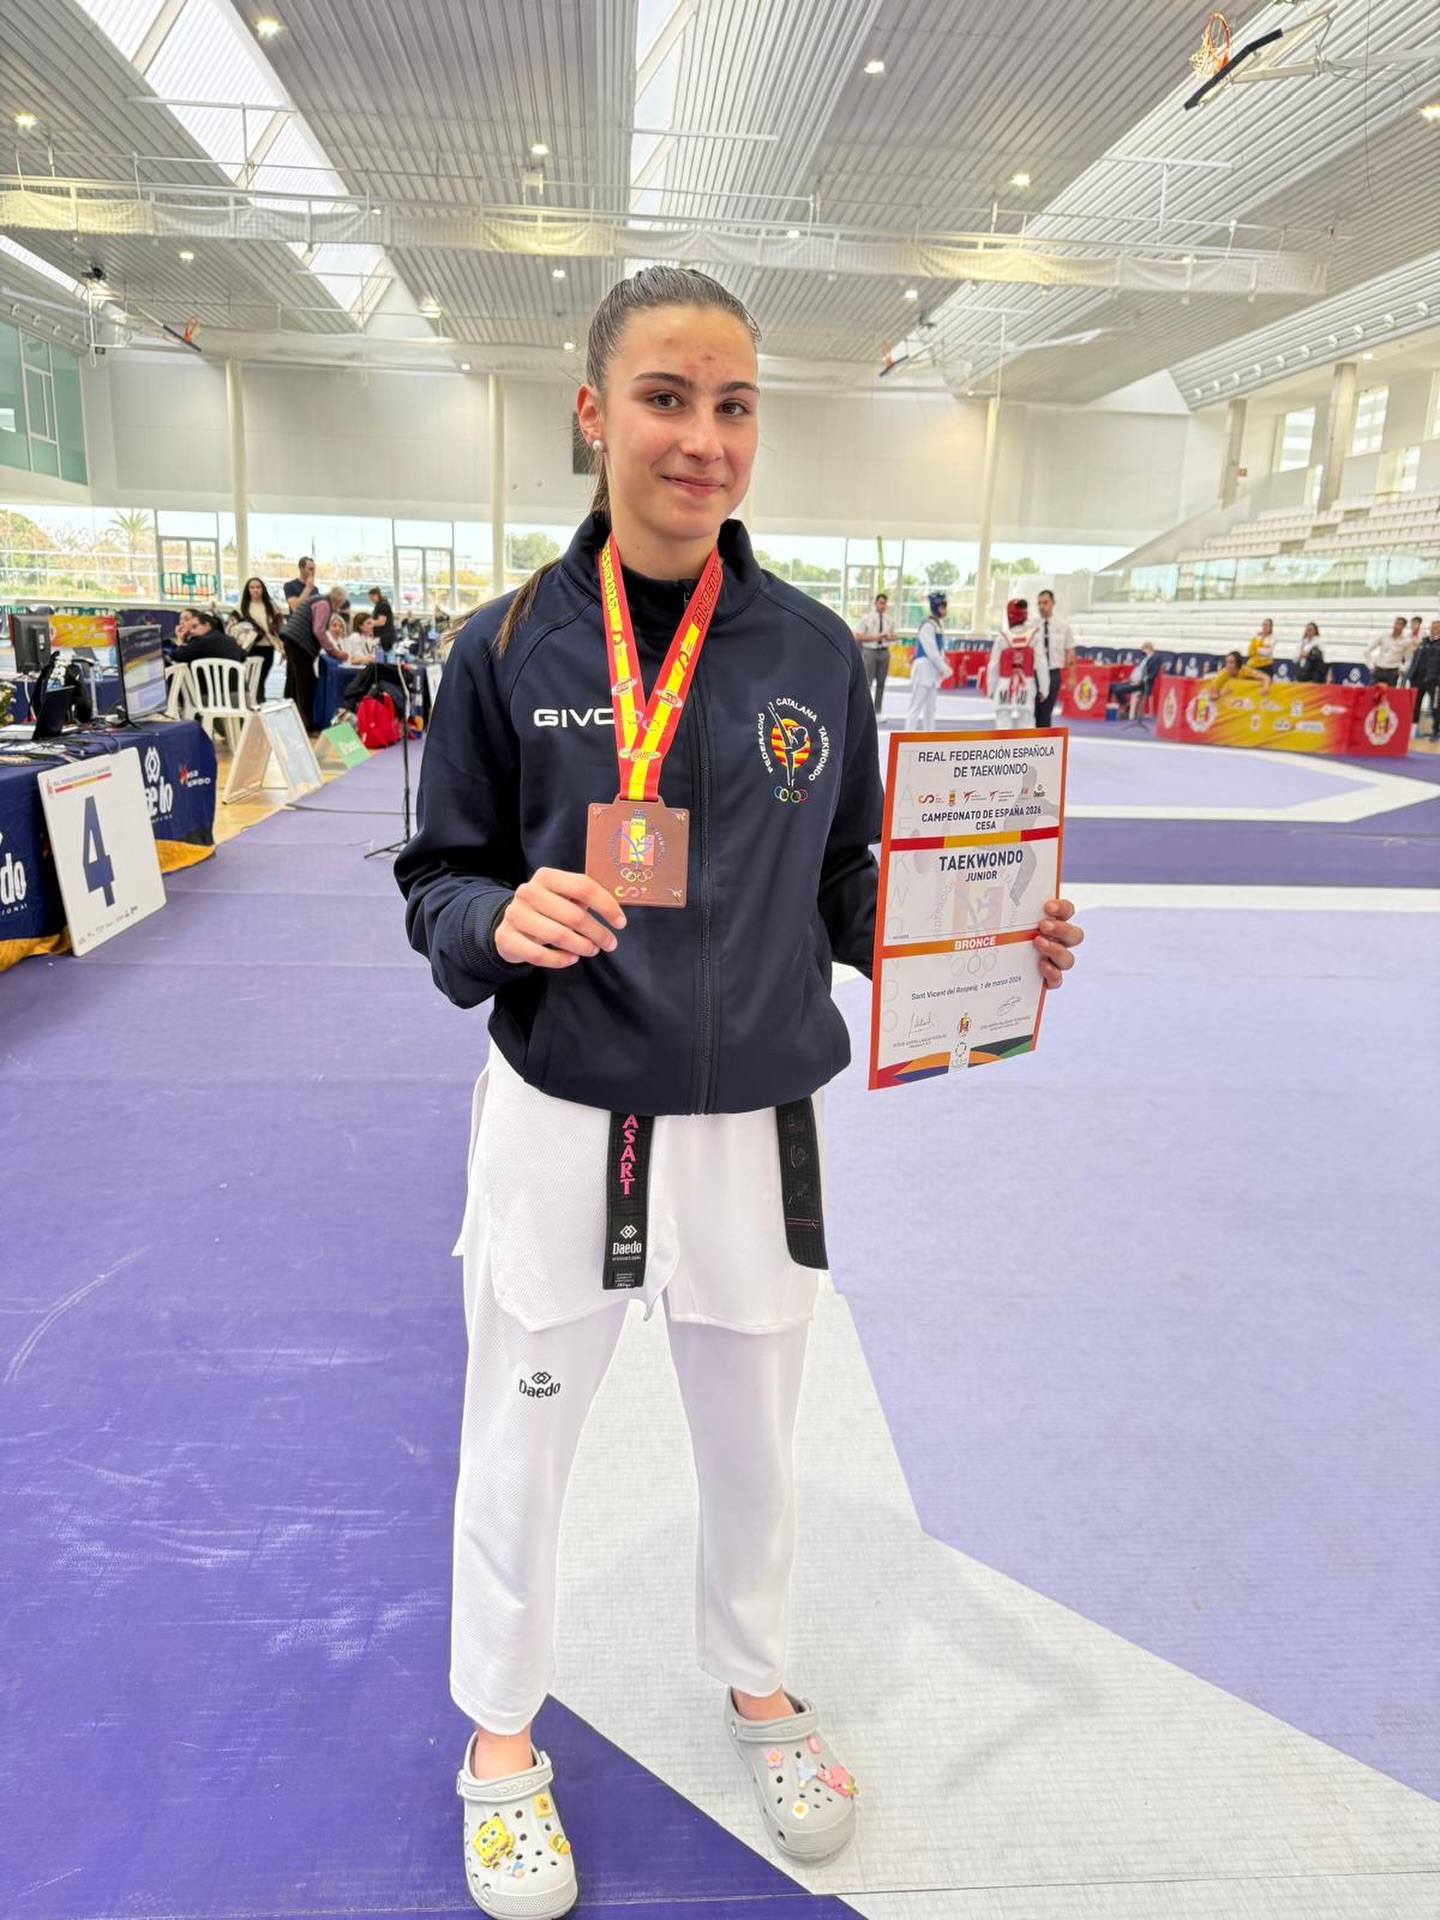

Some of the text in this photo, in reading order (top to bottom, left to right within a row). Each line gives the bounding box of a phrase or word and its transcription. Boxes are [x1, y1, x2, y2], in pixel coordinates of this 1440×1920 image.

[776, 697, 817, 722] CATALANA
[808, 726, 830, 781] TAEKWONDO
[918, 745, 1055, 762] REAL FEDERACIÓN ESPAÑOLA
[954, 763, 1028, 777] DE TAEKWONDO
[921, 805, 1041, 822] CAMPEONATO DE ESPAÑA 2026
[975, 821, 996, 830] CESA
[83, 795, 115, 908] 4
[939, 850, 1023, 871] TAEKWONDO
[966, 870, 998, 882] JUNIOR
[954, 936, 997, 950] BRONCE
[911, 992, 926, 1000] Sant
[926, 989, 946, 998] Vicent
[946, 987, 956, 996] del
[620, 1113, 639, 1196] ASART
[612, 1240, 642, 1255] Daedo
[518, 1378, 561, 1398] Daedo
